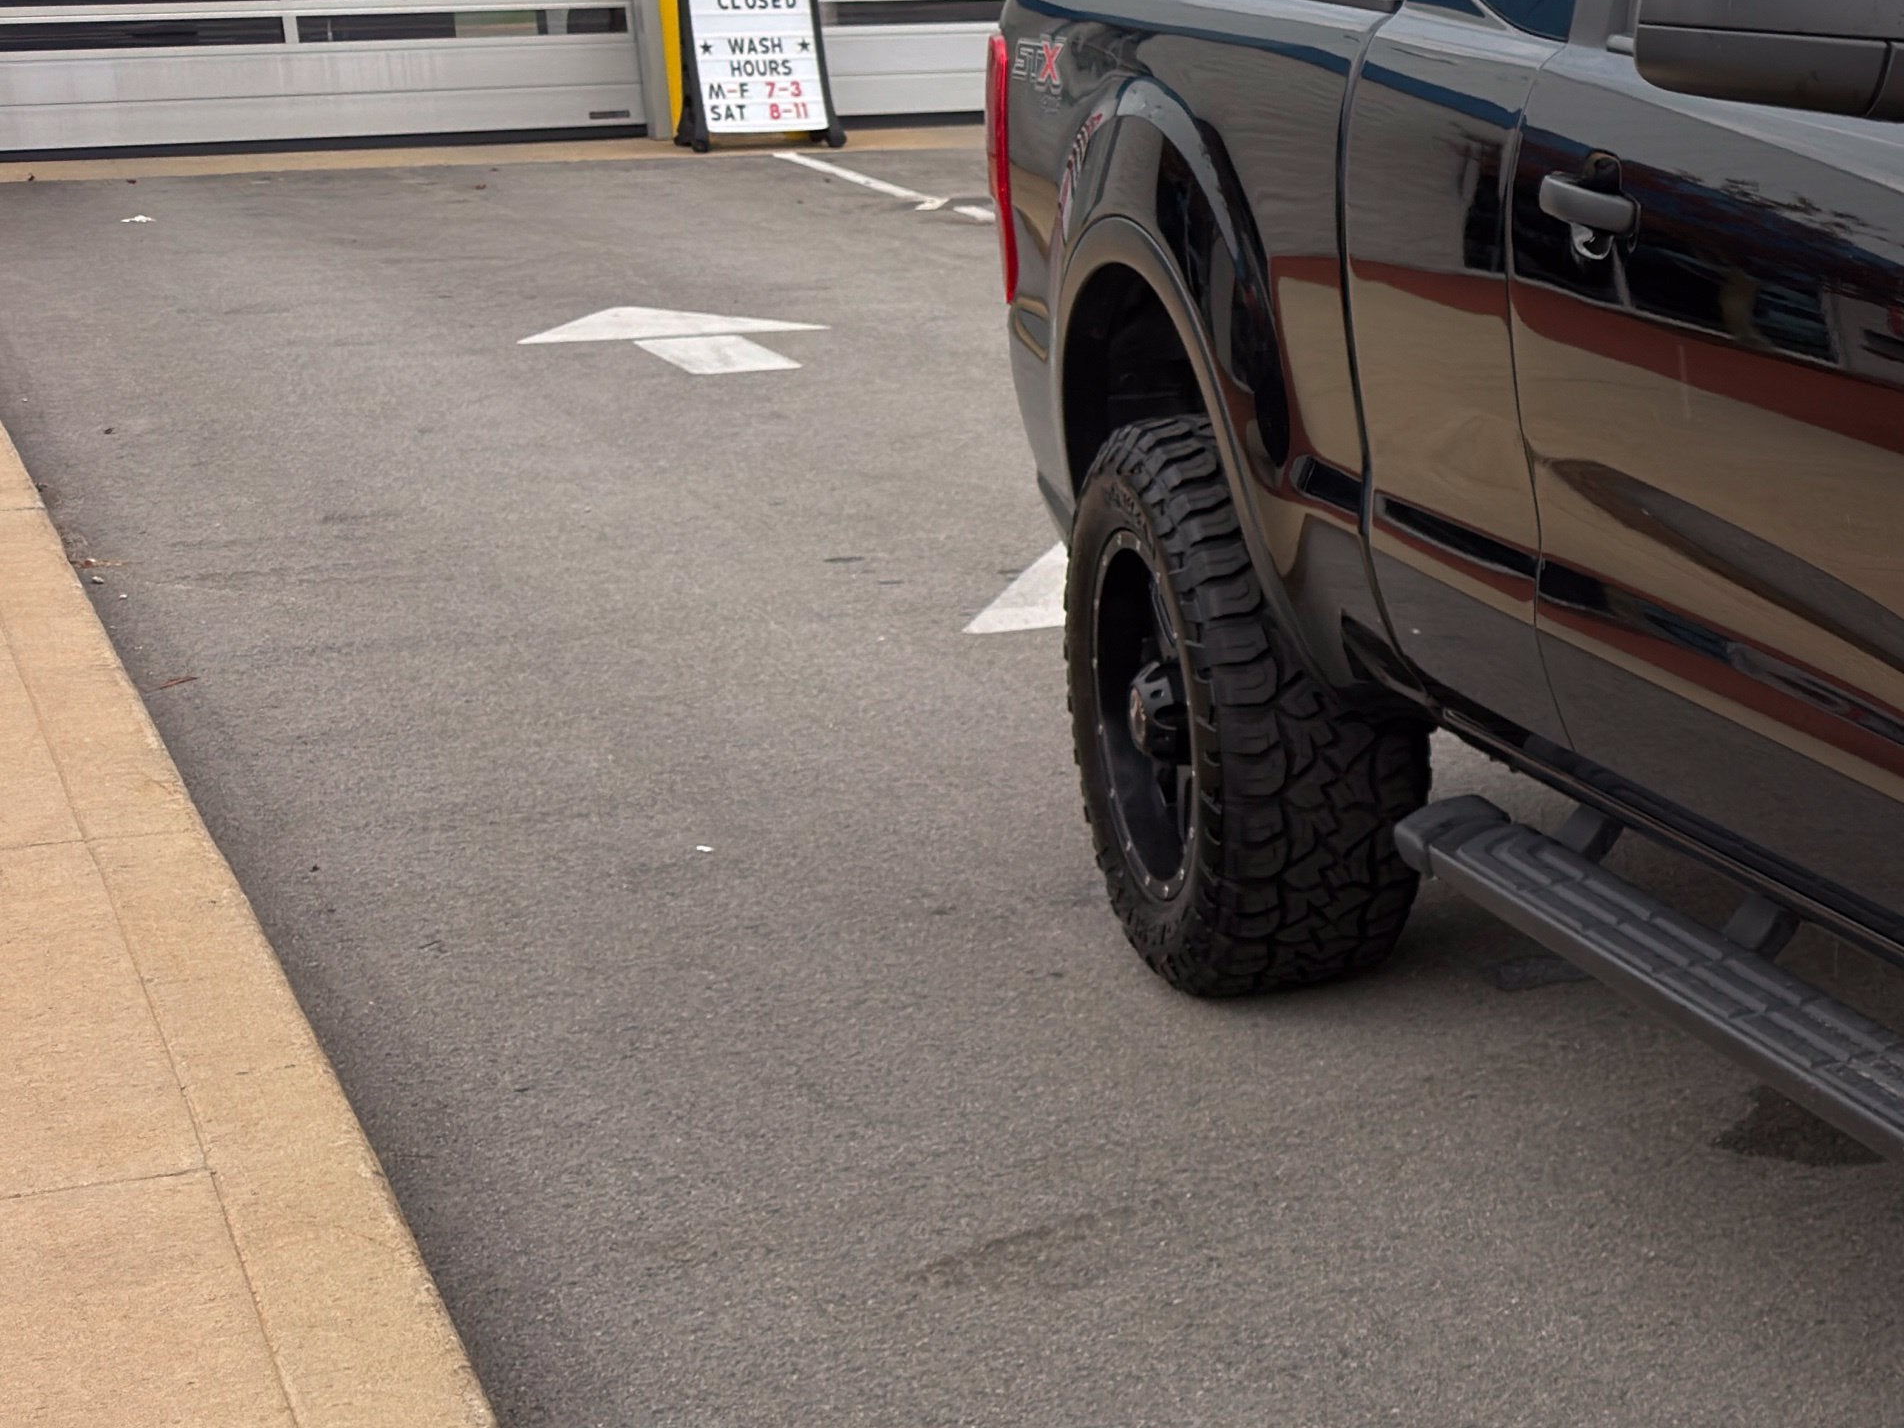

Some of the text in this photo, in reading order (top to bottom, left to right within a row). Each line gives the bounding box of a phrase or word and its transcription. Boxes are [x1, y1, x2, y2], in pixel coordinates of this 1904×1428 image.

[728, 37, 784, 55] WASH
[730, 60, 793, 77] HOURS
[1012, 35, 1066, 94] STX
[709, 81, 803, 100] M-F 7-3
[711, 102, 809, 121] SAT 8-11
